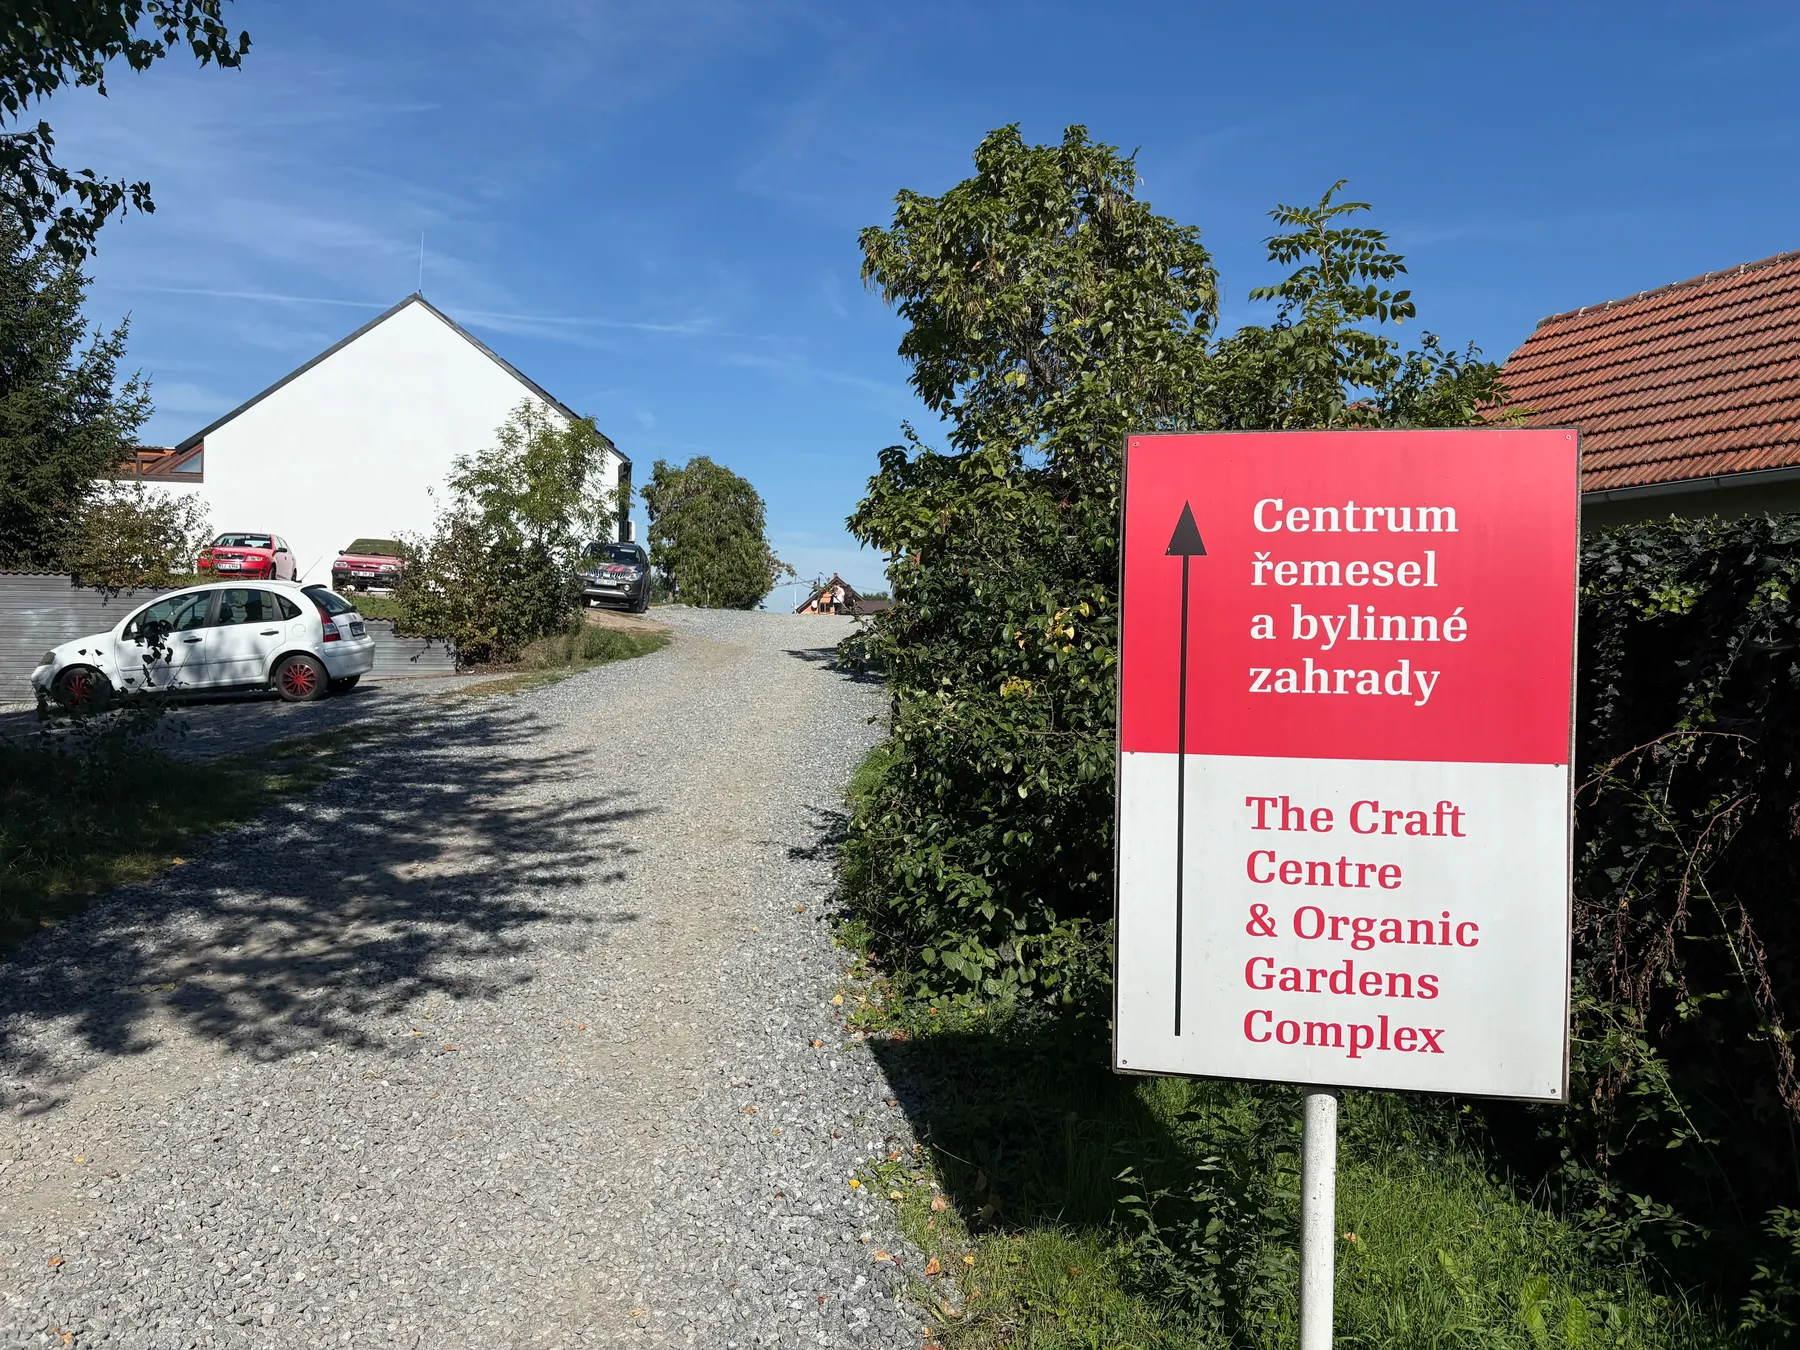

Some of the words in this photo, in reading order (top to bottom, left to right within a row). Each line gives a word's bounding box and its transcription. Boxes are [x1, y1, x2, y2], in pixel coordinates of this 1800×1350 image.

[1254, 498, 1459, 534] Centrum
[1251, 551, 1438, 587] řemesel
[1250, 614, 1276, 640] a
[1291, 604, 1468, 650] bylinné
[1249, 658, 1440, 706] zahrady
[1246, 796, 1333, 833] The
[1349, 801, 1467, 838] Craft
[1246, 850, 1402, 889] Centre
[1246, 903, 1278, 938] &
[1293, 906, 1479, 951] Organic
[1245, 957, 1439, 1000] Gardens
[1243, 1010, 1445, 1059] Complex
